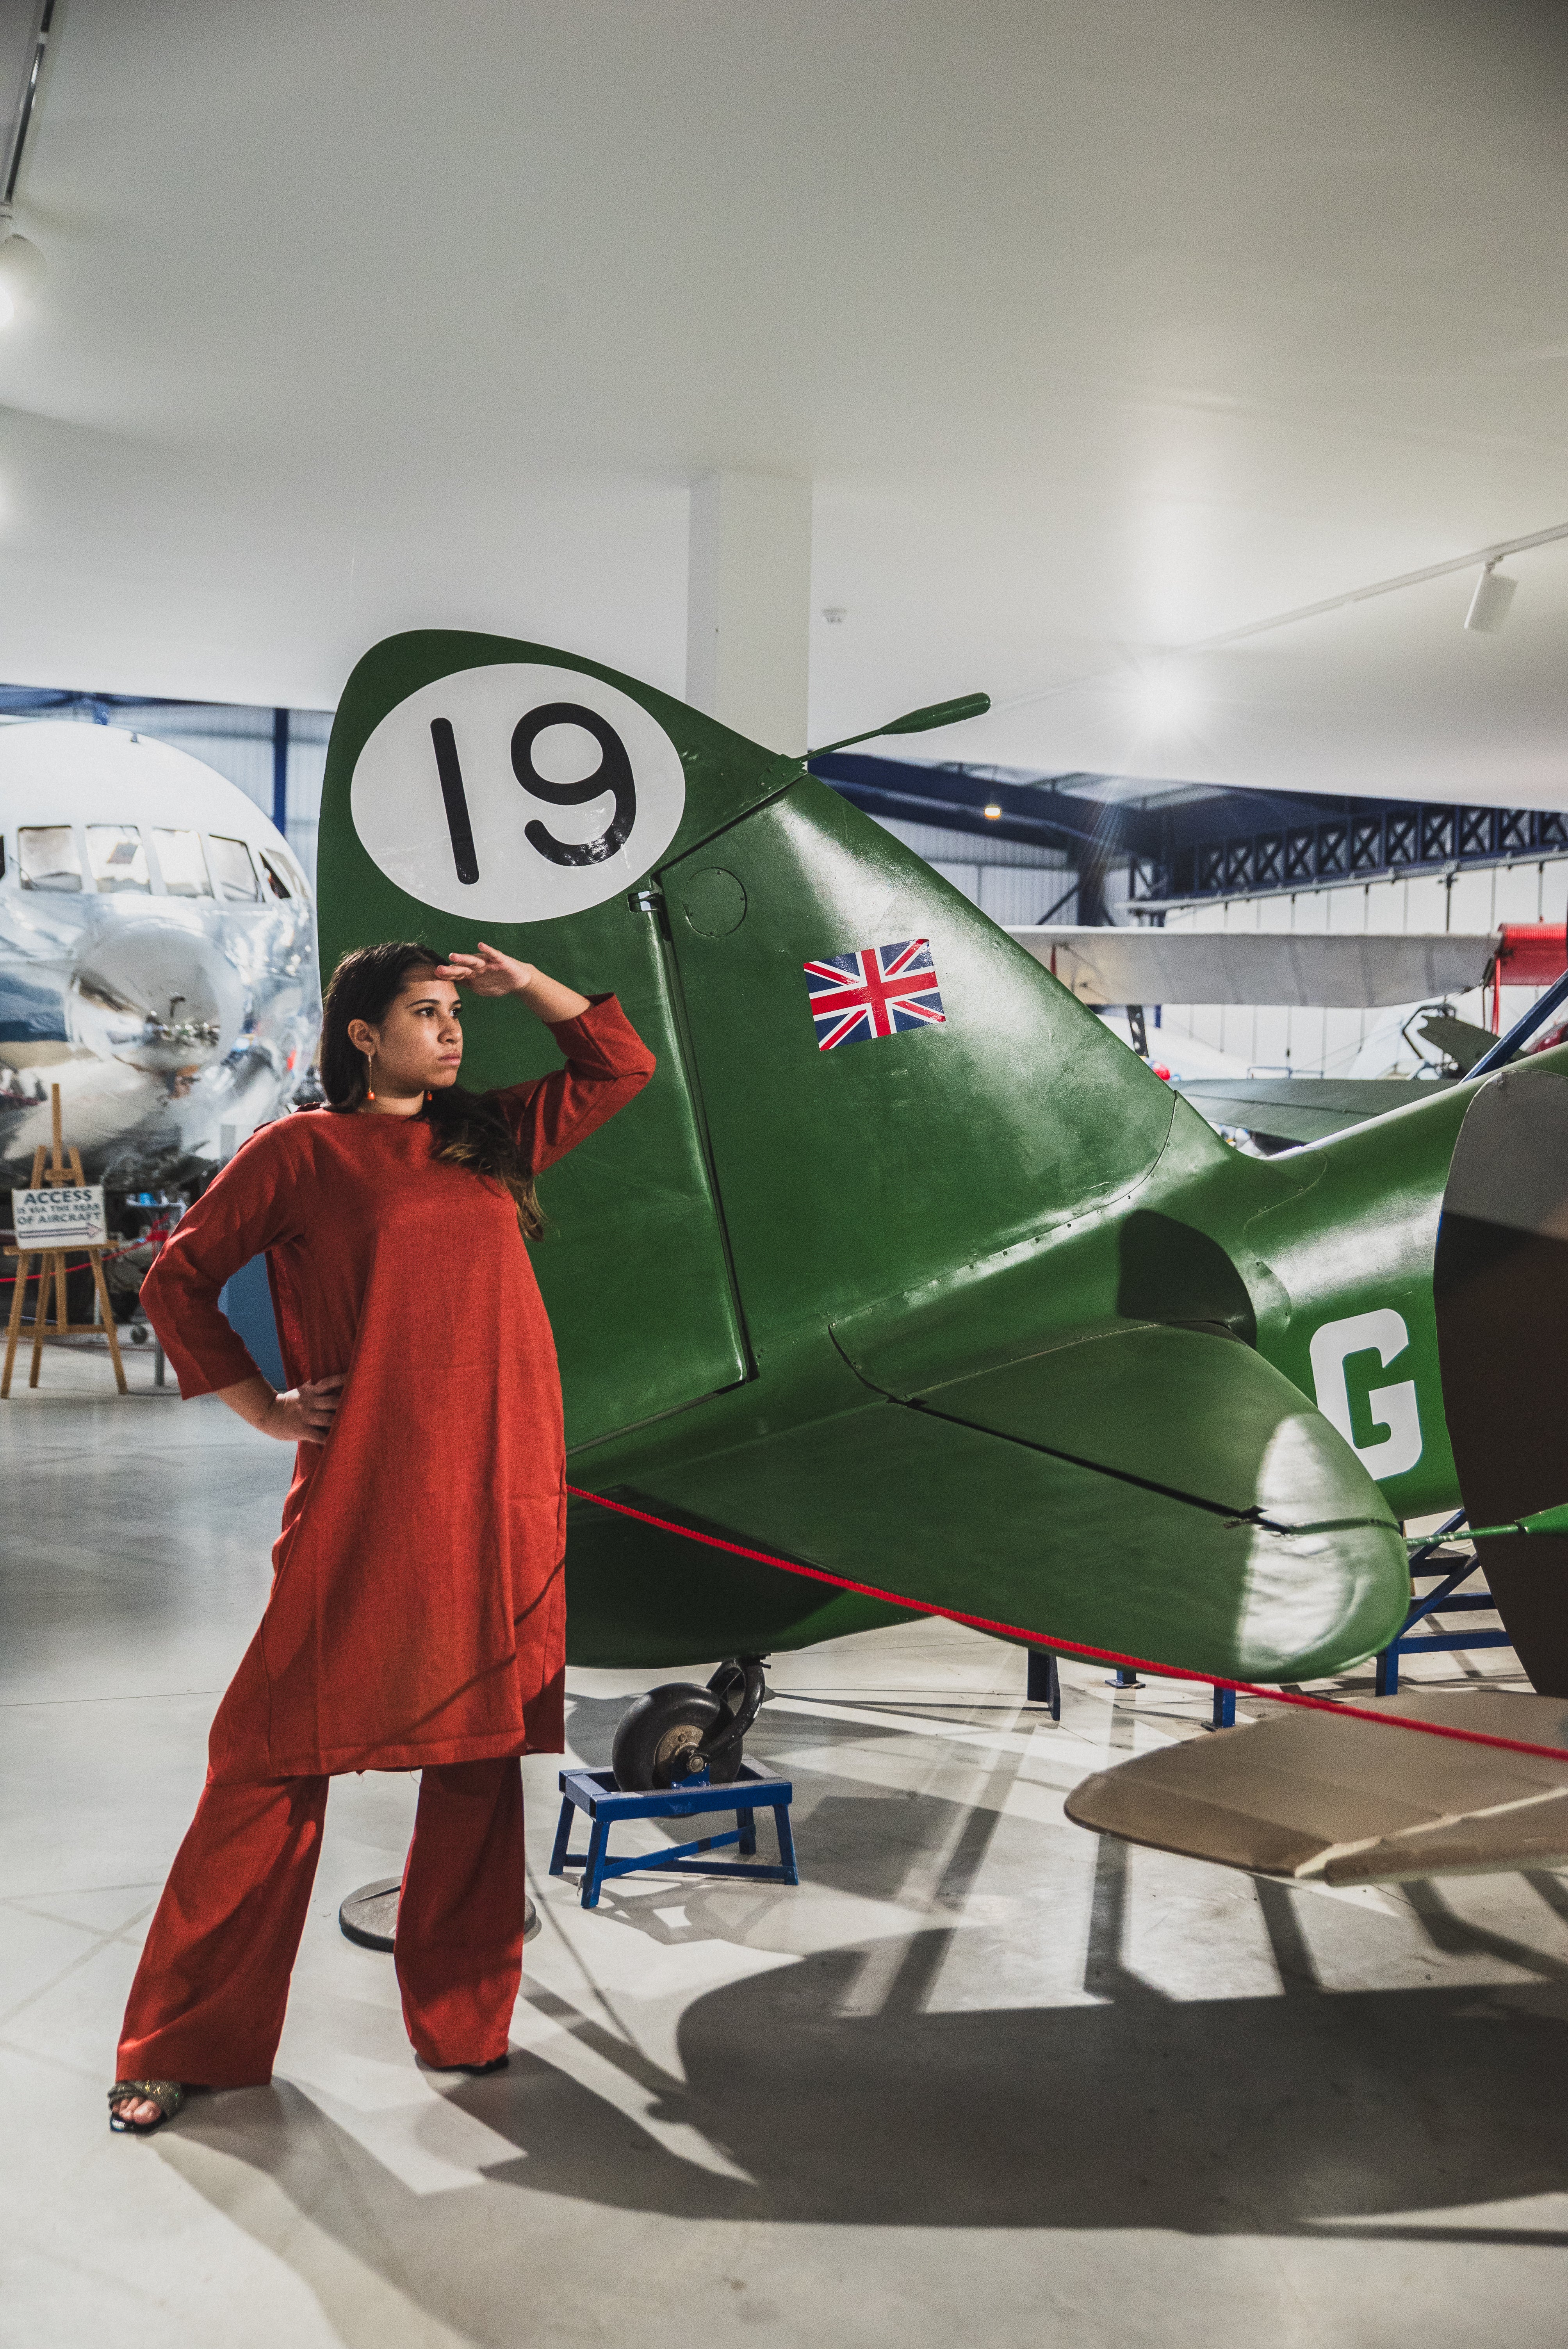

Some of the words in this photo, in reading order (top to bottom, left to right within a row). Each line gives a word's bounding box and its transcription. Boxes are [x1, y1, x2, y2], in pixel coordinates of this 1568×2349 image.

[430, 702, 637, 885] 19
[18, 1215, 34, 1225] OF
[39, 1212, 101, 1223] AIRCRAFT
[24, 1190, 92, 1204] ACCESS
[1309, 1308, 1422, 1481] G
